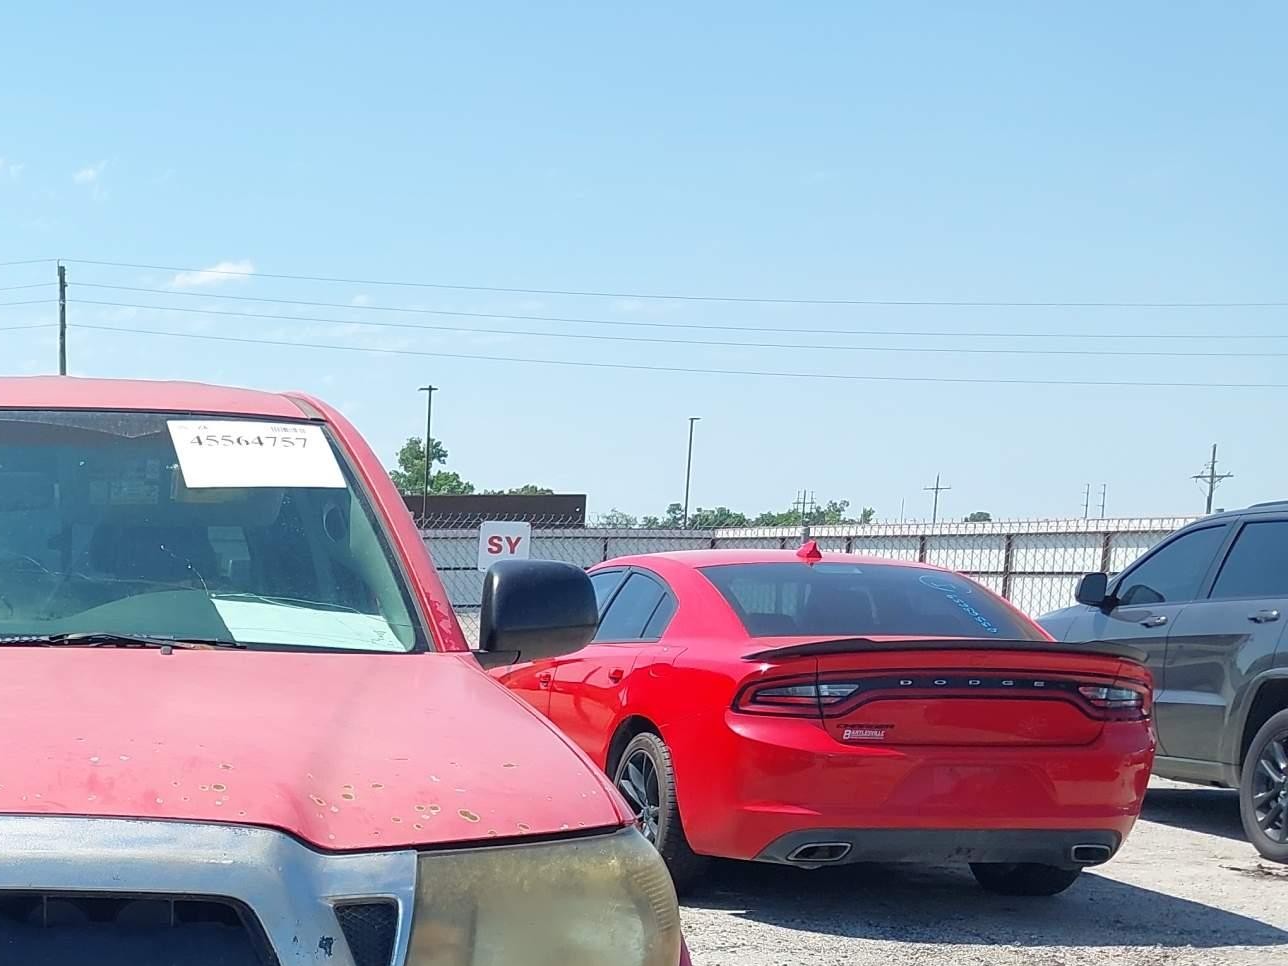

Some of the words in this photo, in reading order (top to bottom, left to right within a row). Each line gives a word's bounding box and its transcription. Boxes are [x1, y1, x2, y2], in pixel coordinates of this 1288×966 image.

[190, 434, 308, 449] 45564757
[487, 535, 522, 555] SY
[899, 679, 1045, 687] DODGE
